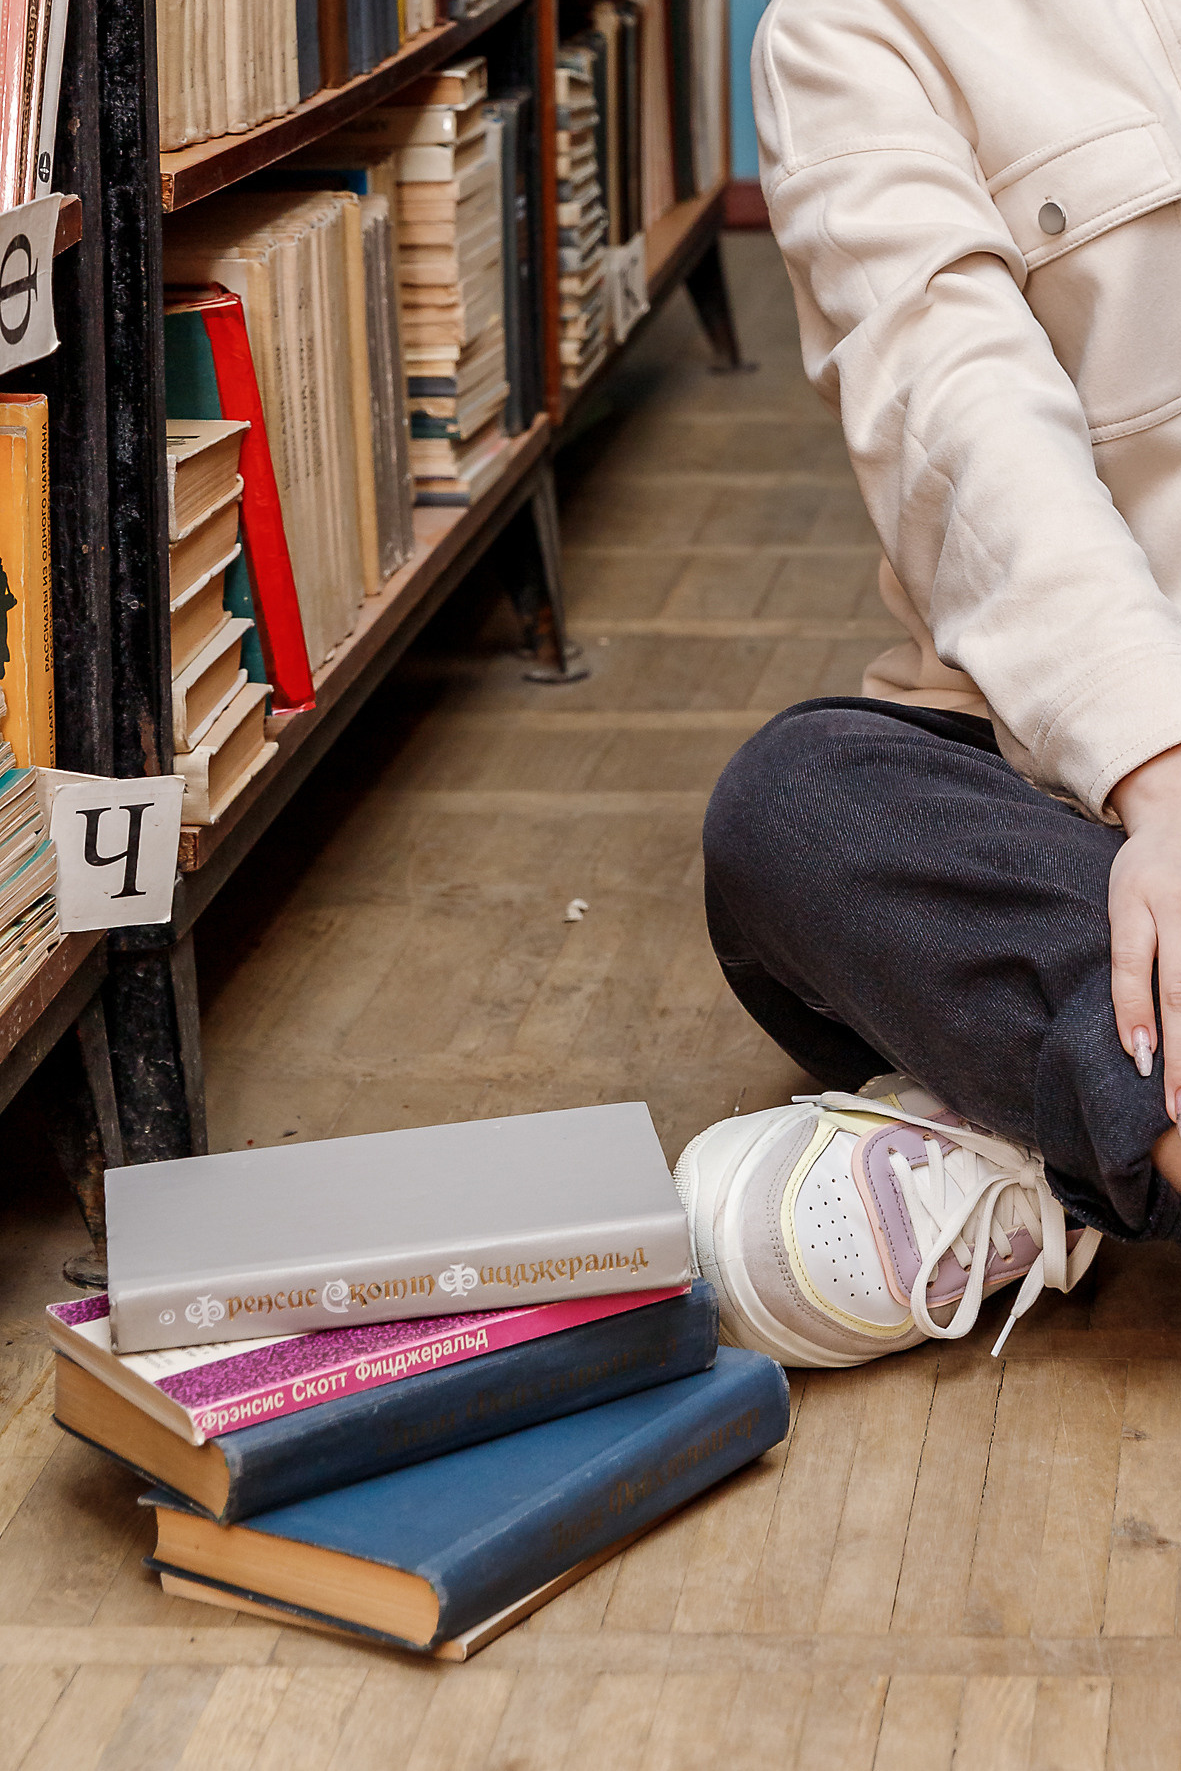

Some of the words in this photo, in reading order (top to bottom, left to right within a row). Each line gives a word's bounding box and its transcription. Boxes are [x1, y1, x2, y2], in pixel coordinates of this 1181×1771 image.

[0, 234, 38, 345] Ф
[42, 565, 48, 587] ИЗ
[42, 589, 50, 672] РАССКАЗЫ
[75, 801, 155, 900] Ч
[184, 1286, 319, 1329] Френсис
[321, 1270, 436, 1314] Скотт
[437, 1247, 649, 1297] Фицджеральд
[200, 1390, 286, 1433] Фрэнсис
[291, 1372, 348, 1403] Скотт
[354, 1327, 489, 1383] Фицджеральд
